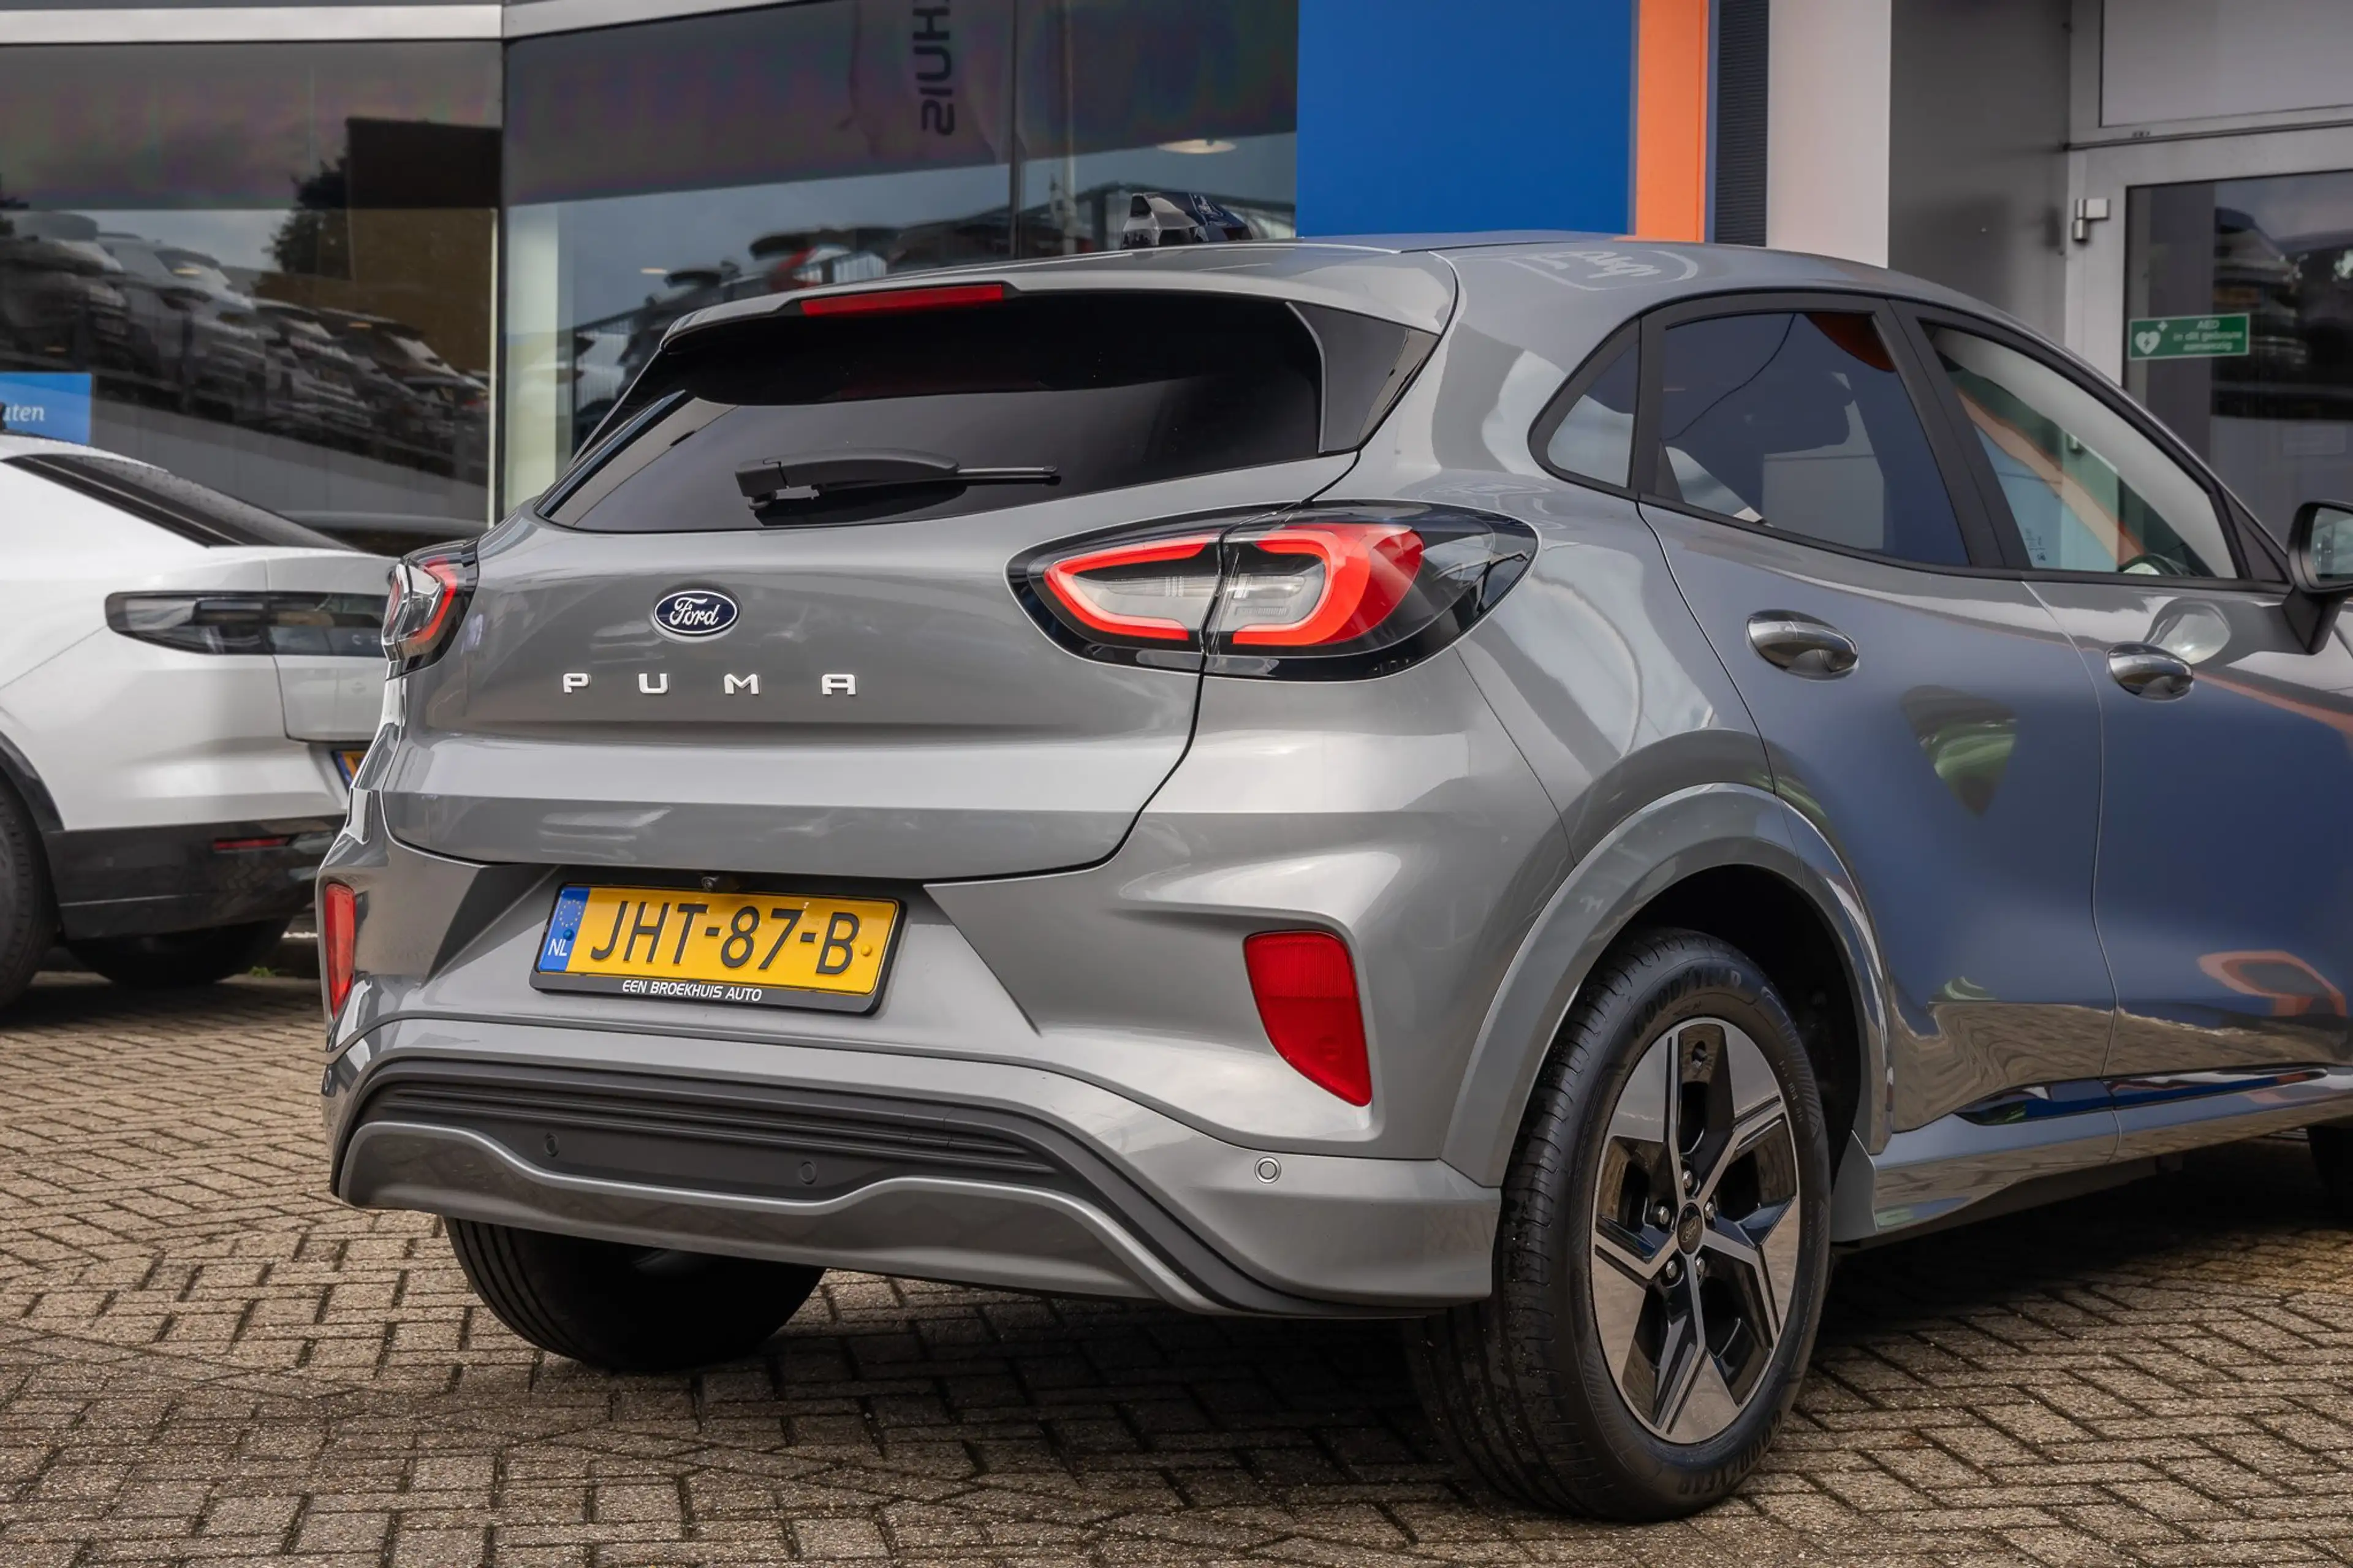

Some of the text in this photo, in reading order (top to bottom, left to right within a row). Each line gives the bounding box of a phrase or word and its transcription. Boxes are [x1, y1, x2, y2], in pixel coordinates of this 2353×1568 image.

[669, 596, 719, 626] Ford
[563, 673, 857, 695] PUMA
[548, 937, 567, 958] NL
[590, 900, 860, 976] JHT-87-B
[622, 980, 762, 1002] EEN BROEKHUIS AUTO
